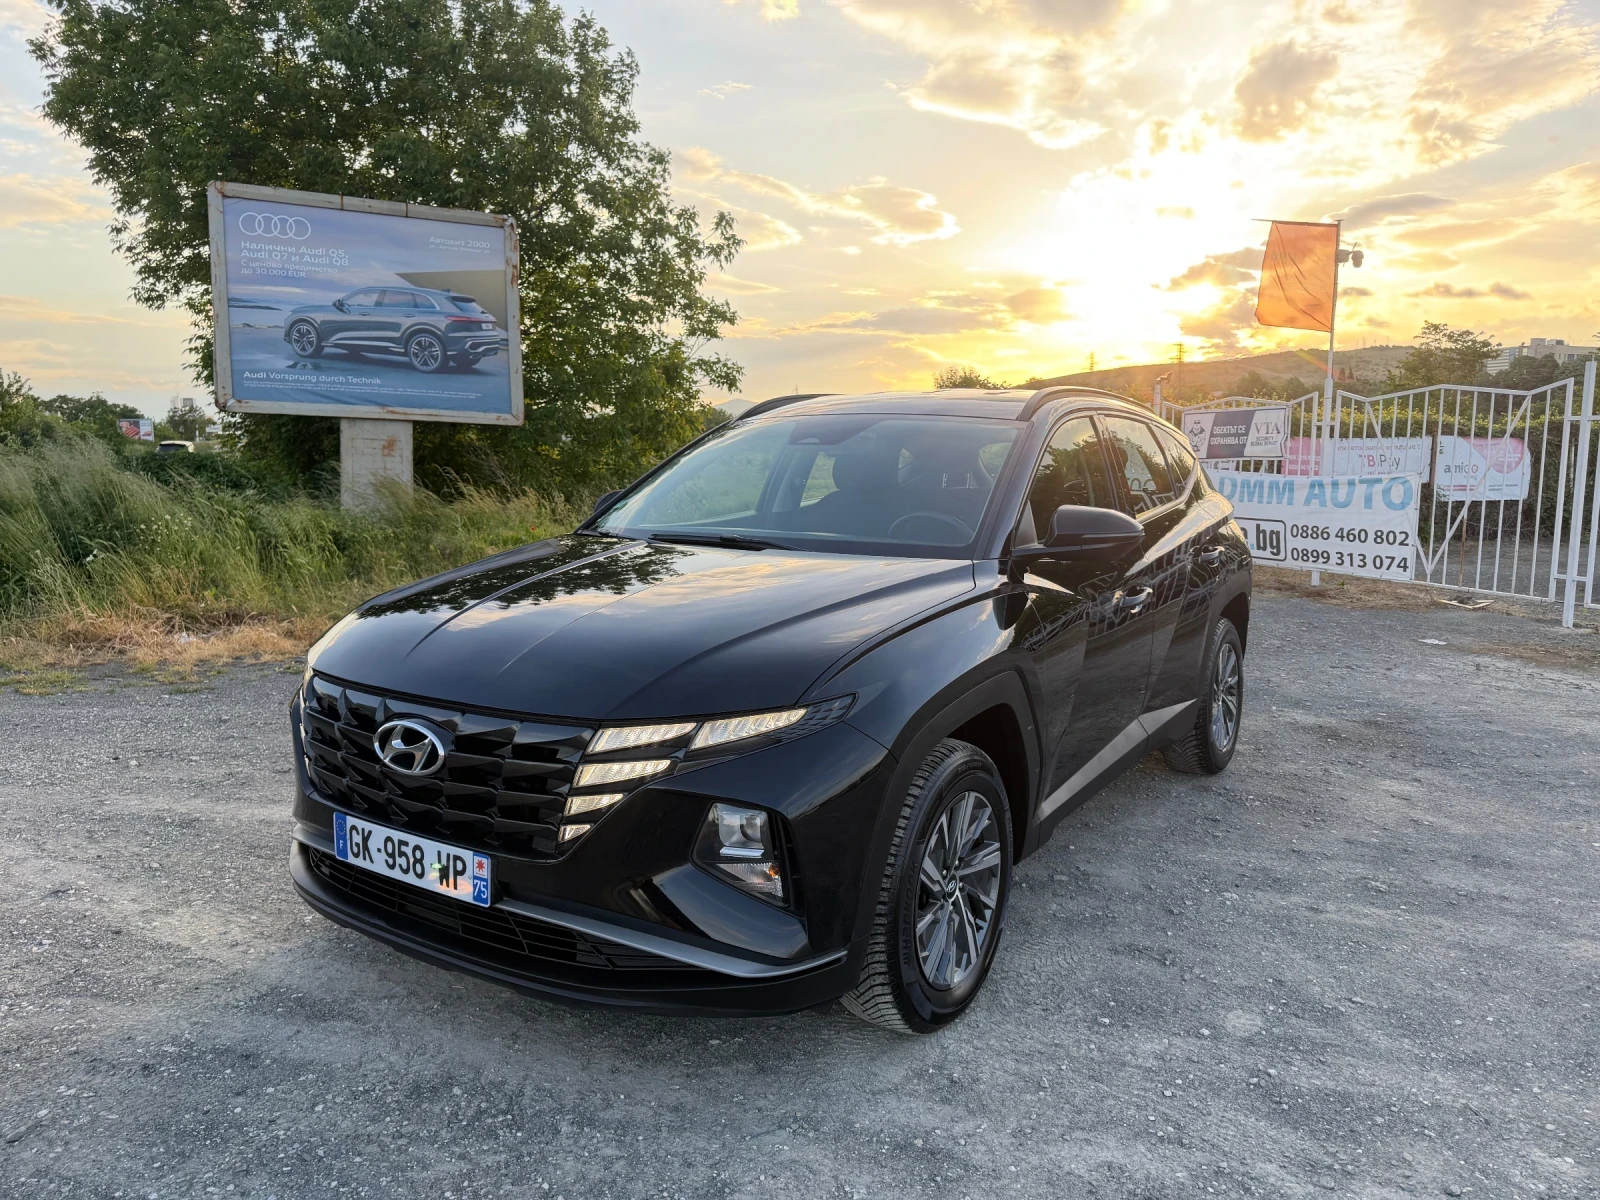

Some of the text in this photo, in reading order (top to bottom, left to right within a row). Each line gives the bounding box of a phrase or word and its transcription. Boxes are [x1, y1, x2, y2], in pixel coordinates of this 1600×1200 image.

[241, 240, 296, 253] Налични
[299, 246, 326, 256] Audi
[429, 236, 466, 246] Автохит
[467, 240, 491, 249] 2000
[241, 249, 268, 259] Audi
[272, 252, 288, 261] Q7
[302, 254, 329, 264] Audi
[333, 257, 349, 266] Q8
[249, 260, 283, 269] ценово
[284, 263, 338, 274] предимство
[255, 267, 267, 275] 30
[269, 268, 287, 276] 000
[288, 270, 306, 278] EUR
[243, 371, 382, 385] Audi Vorsprung durch Technik
[1212, 425, 1247, 434] ОБЕКТЪТ СЕ
[1254, 422, 1281, 435] VTA
[1210, 436, 1248, 445] ОХРАНЯВА ОТ
[1218, 476, 1414, 511] DMM AUTO
[1290, 524, 1330, 540] 0886
[1334, 527, 1369, 543] 460
[1373, 529, 1410, 547] 802
[1291, 547, 1409, 572] 0899 313 074
[339, 840, 344, 850] F
[473, 879, 488, 899] 75
